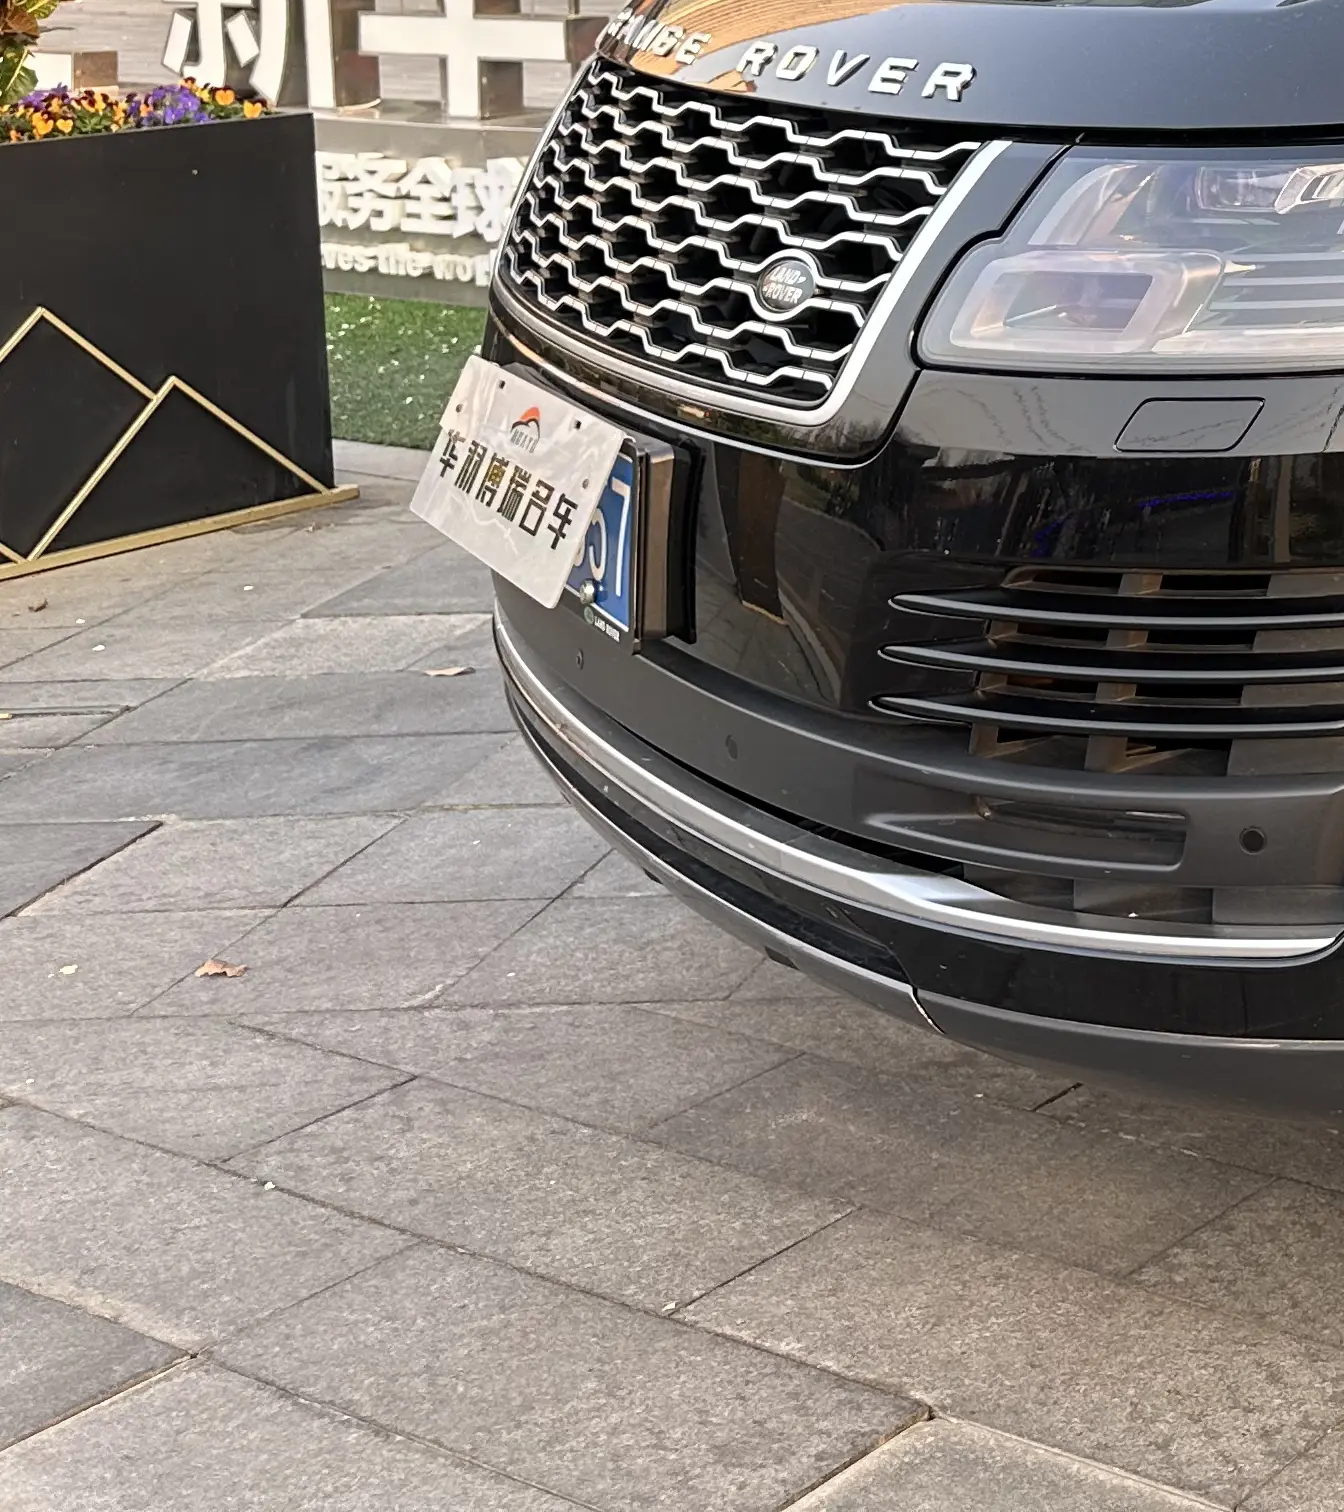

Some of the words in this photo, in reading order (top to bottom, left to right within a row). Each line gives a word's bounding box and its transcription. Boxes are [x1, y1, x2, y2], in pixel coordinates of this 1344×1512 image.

[736, 40, 977, 103] ROVER
[769, 265, 802, 285] LAND
[764, 282, 803, 304] ROVER
